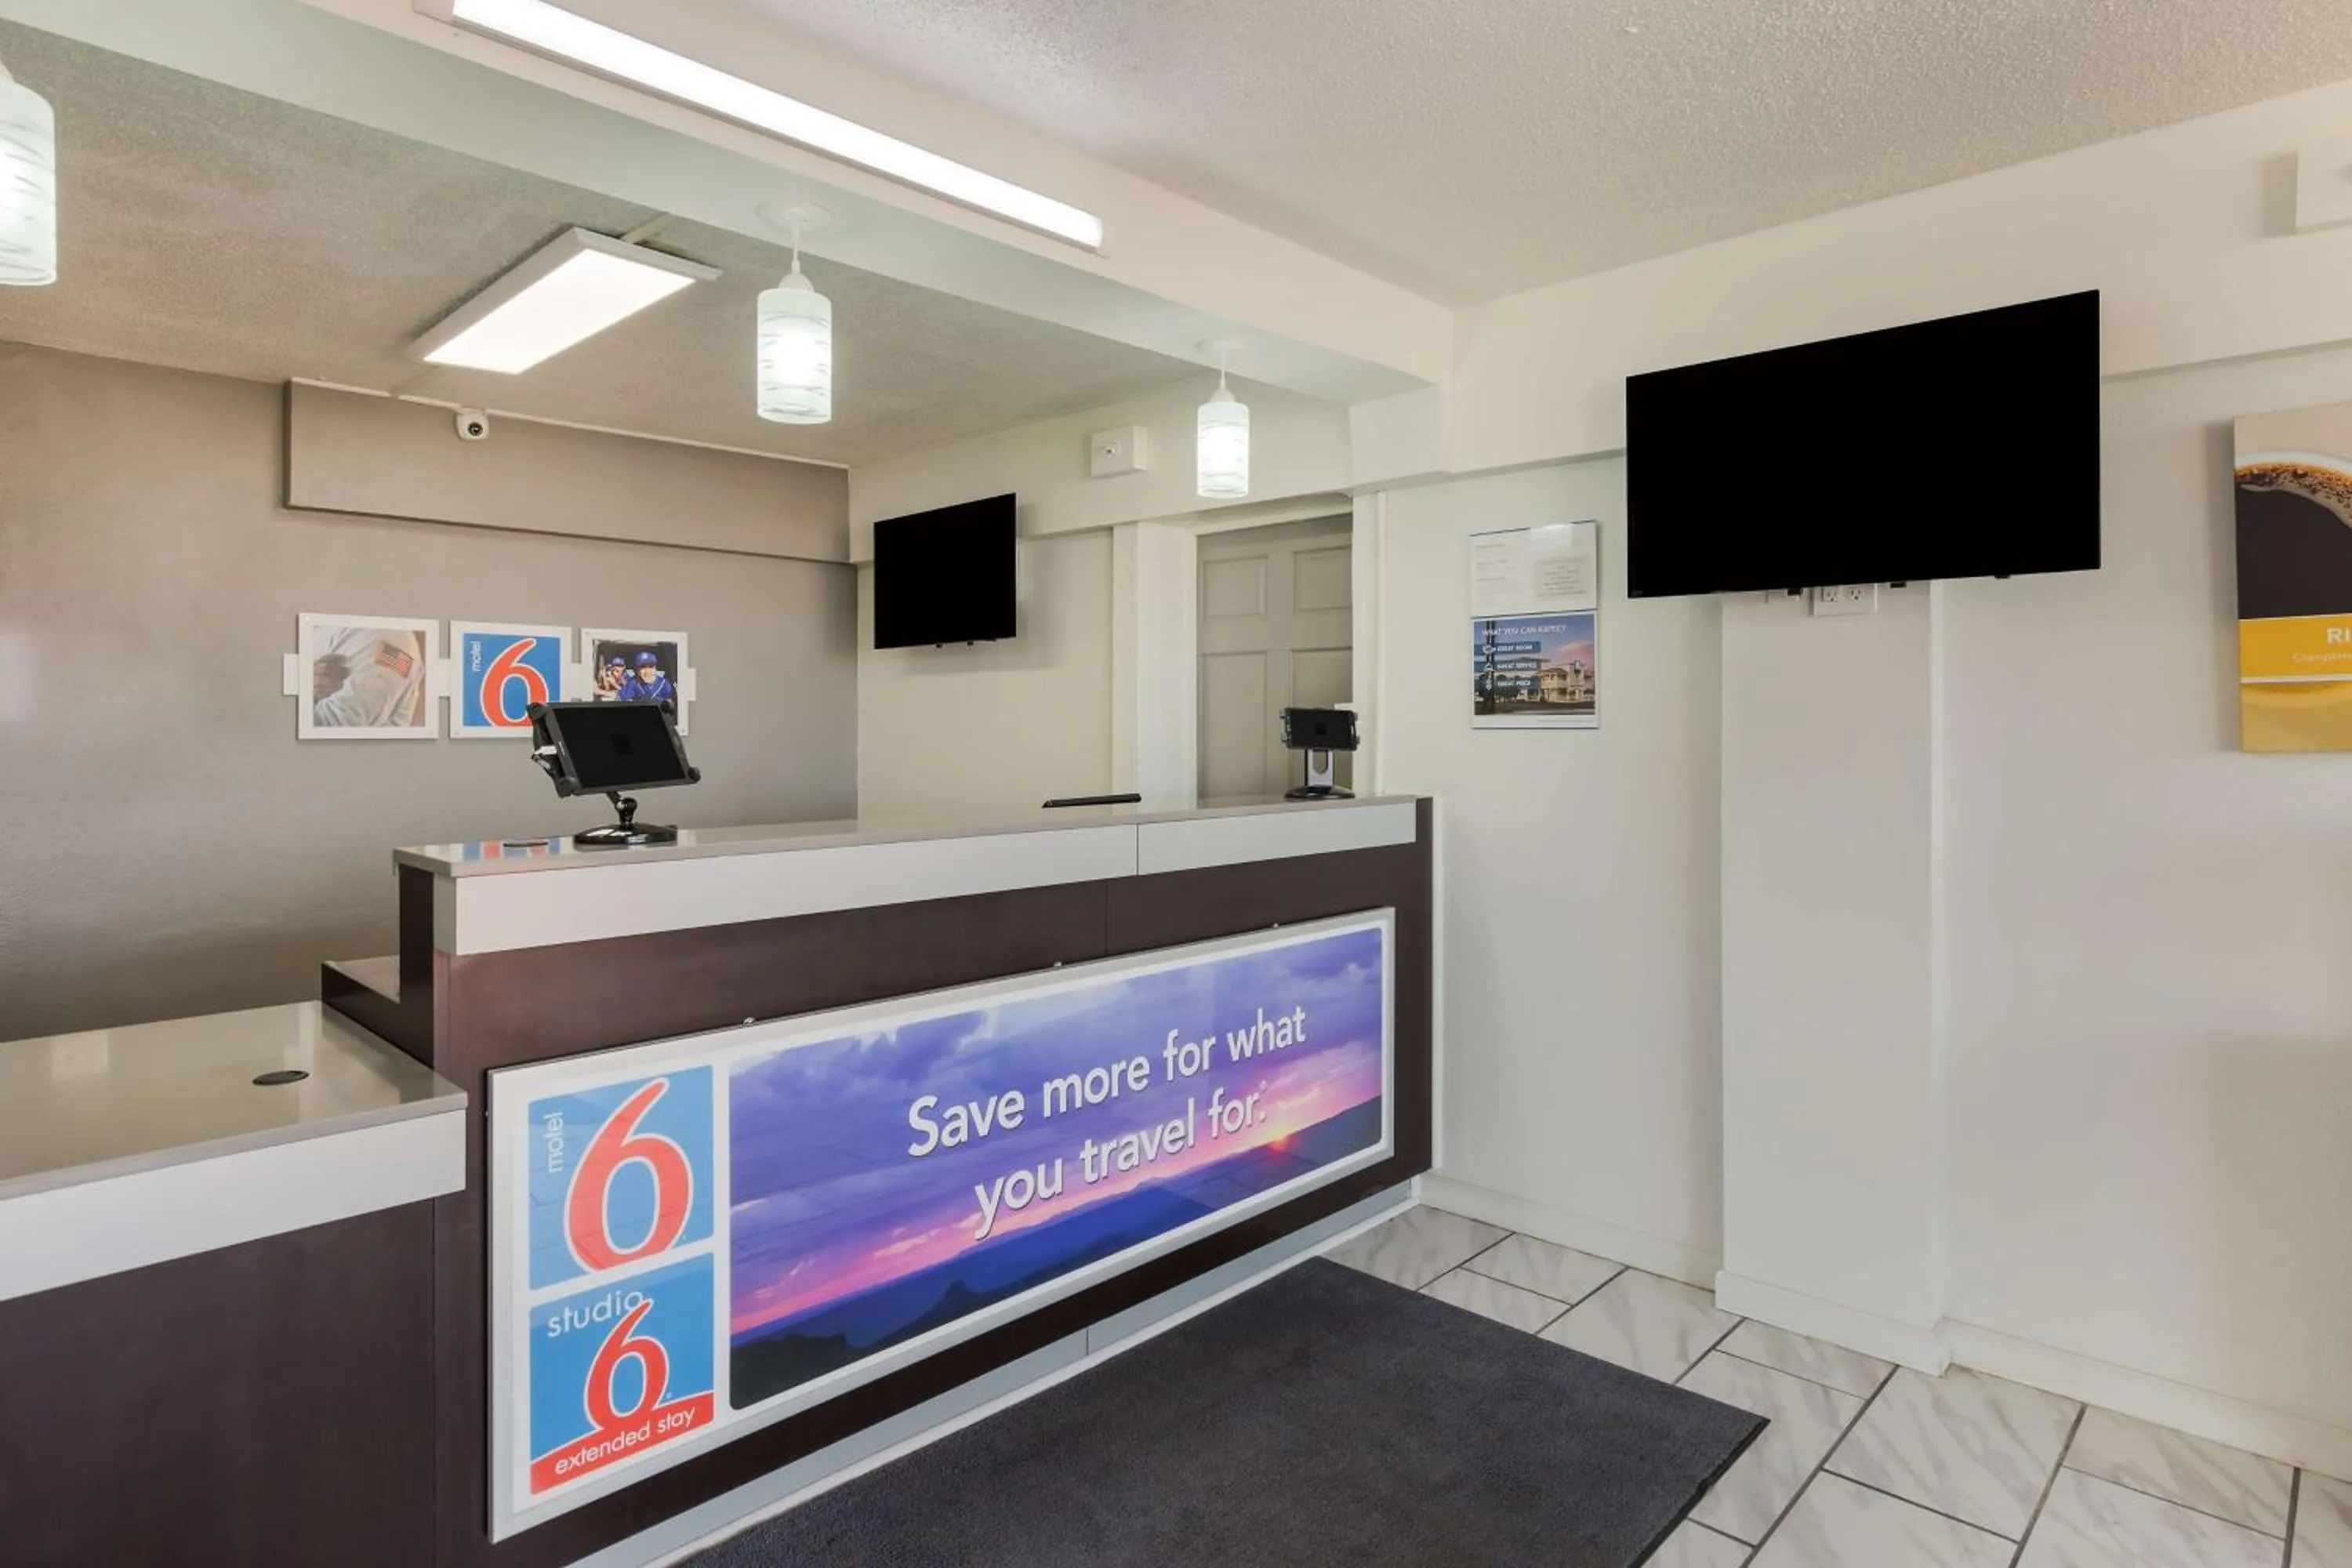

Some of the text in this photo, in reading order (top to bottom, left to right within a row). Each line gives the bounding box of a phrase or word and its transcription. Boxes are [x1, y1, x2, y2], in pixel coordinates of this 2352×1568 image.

[470, 641, 481, 672] motel
[480, 637, 550, 728] 6
[908, 1007, 1307, 1157] Save more for what
[543, 1111, 564, 1174] motel
[564, 1076, 695, 1274] 6
[974, 1157, 1063, 1240] you
[1080, 1098, 1196, 1184] travel
[546, 1290, 644, 1338] studio
[583, 1298, 670, 1431] 6
[554, 1406, 696, 1475] extended stay
